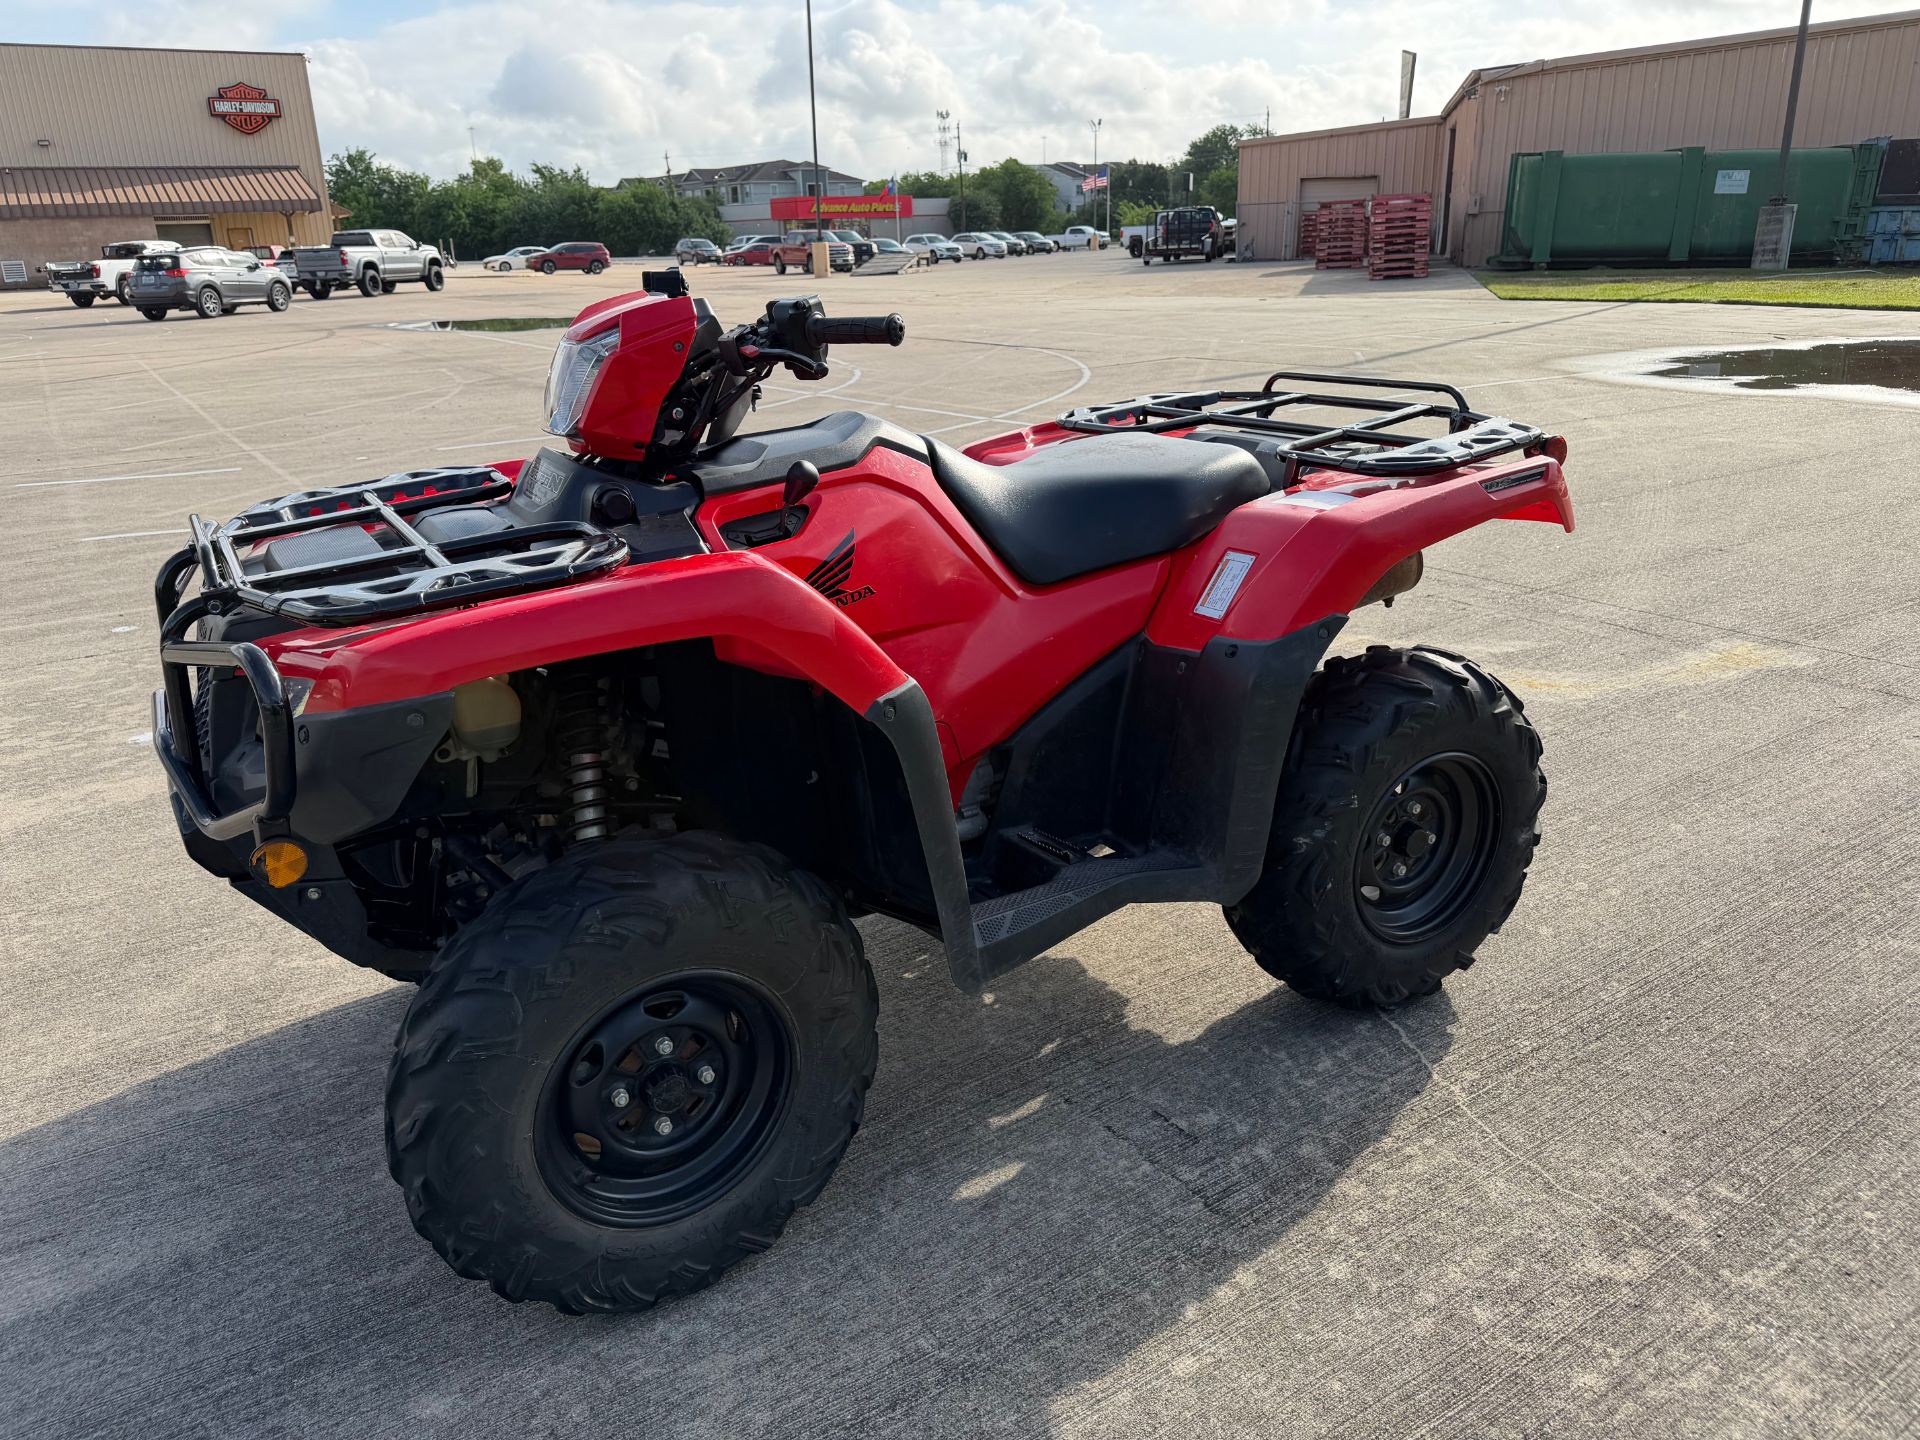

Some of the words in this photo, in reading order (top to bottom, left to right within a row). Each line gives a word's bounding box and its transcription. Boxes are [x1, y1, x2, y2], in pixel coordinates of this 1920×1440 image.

[227, 88, 259, 98] MOTOR
[214, 100, 276, 114] HARLEY-DAVIDSON
[230, 115, 263, 130] CYCLES
[848, 202, 870, 213] Auto
[834, 585, 876, 608] NDA
